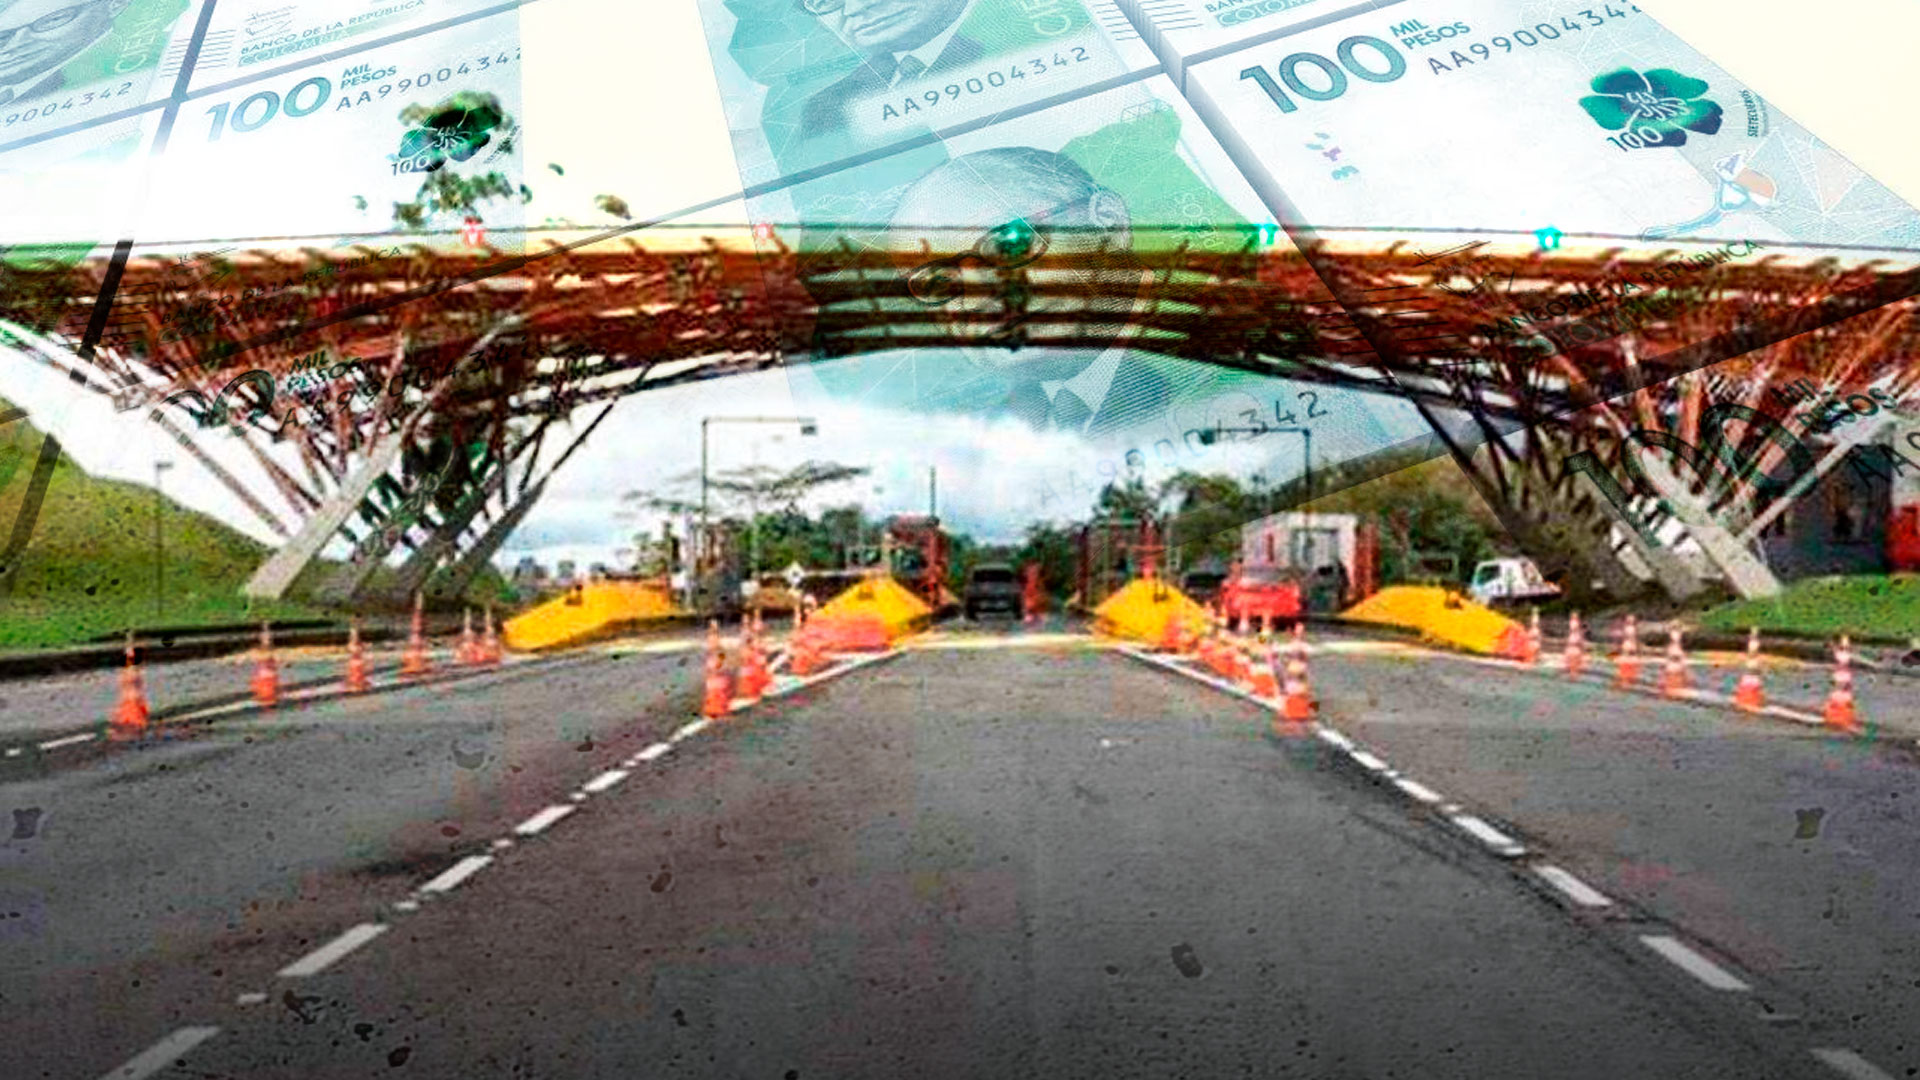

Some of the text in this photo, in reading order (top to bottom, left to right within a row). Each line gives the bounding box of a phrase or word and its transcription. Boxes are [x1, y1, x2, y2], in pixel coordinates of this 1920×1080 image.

[241, 33, 298, 55] BANCO
[302, 27, 321, 38] DE
[326, 21, 344, 31] LA
[1389, 18, 1429, 37] MIL
[1400, 21, 1471, 50] PESOS
[340, 65, 398, 90] PESOS
[342, 64, 373, 79] MIL
[881, 46, 1091, 121] AA99004342
[1240, 35, 1406, 113] 100
[205, 76, 332, 142] 100
[1606, 125, 1664, 152] 100
[1606, 276, 1643, 298] LA
[288, 350, 328, 374] MIL
